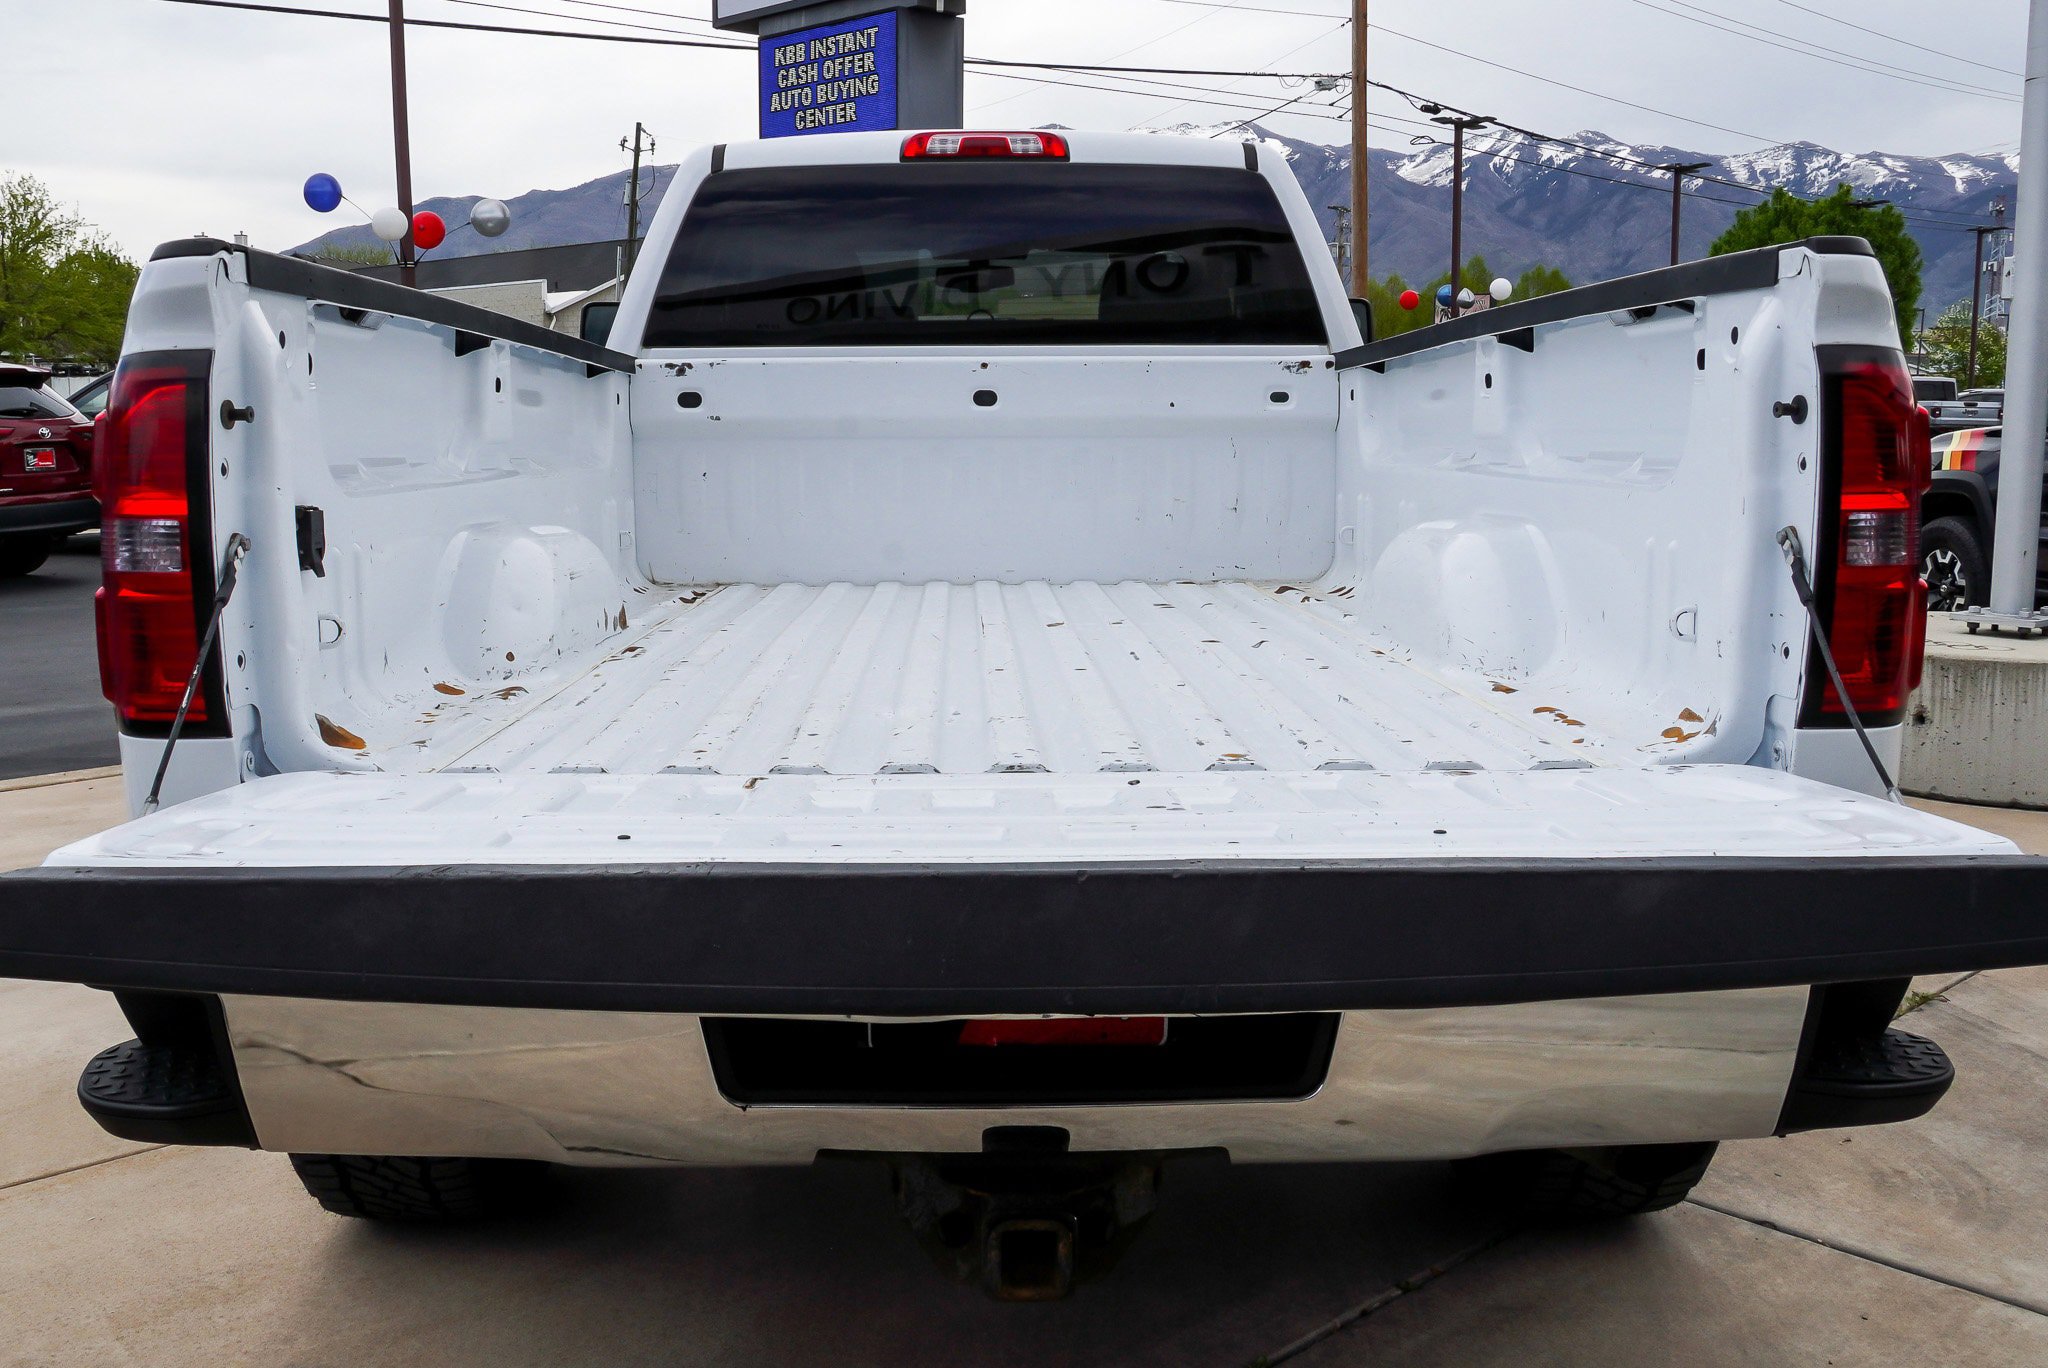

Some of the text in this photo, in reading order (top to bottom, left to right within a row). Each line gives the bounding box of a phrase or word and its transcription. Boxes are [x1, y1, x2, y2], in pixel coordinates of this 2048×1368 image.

[774, 27, 879, 67] KBB INSTANT
[778, 51, 875, 88] CASH OFFER
[770, 75, 879, 112] AUTO BUYING
[795, 101, 857, 130] CENTER
